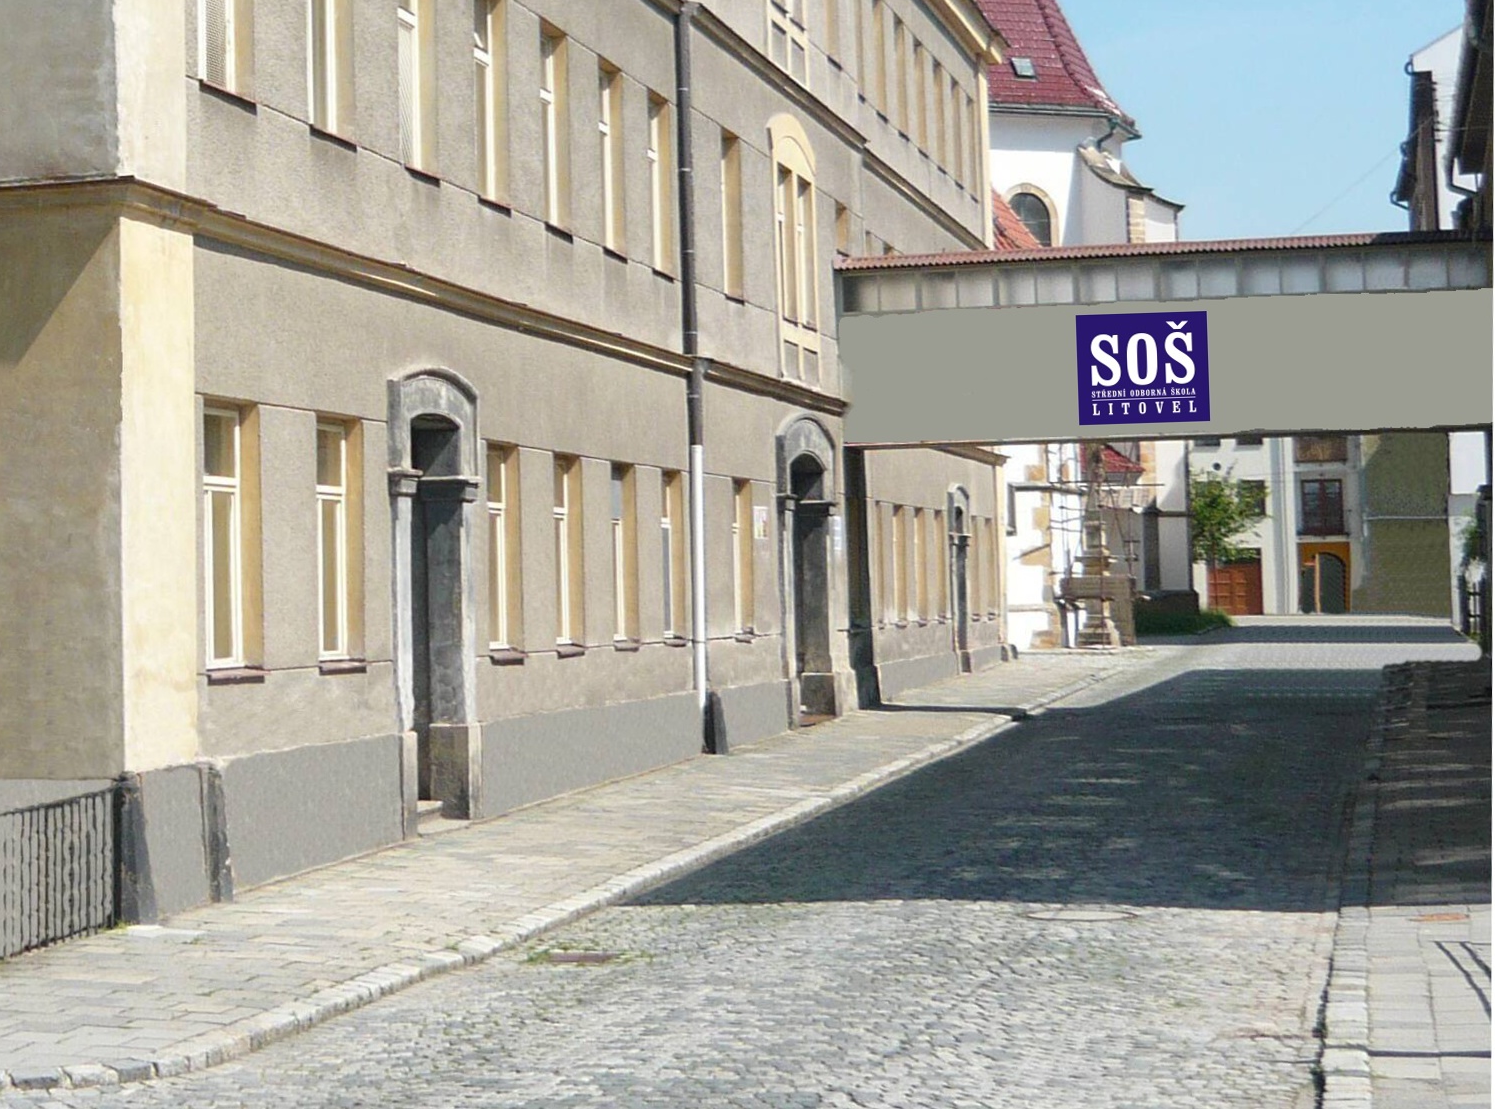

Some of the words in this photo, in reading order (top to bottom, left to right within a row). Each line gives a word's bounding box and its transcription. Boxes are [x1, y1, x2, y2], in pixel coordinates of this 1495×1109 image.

[1090, 320, 1196, 387] SOŠ
[1091, 388, 1126, 398] STŘEDNÍ
[1130, 387, 1167, 397] ODBORNÁ
[1170, 387, 1196, 396] ŠKOLA
[1092, 400, 1197, 416] LITOVEL
